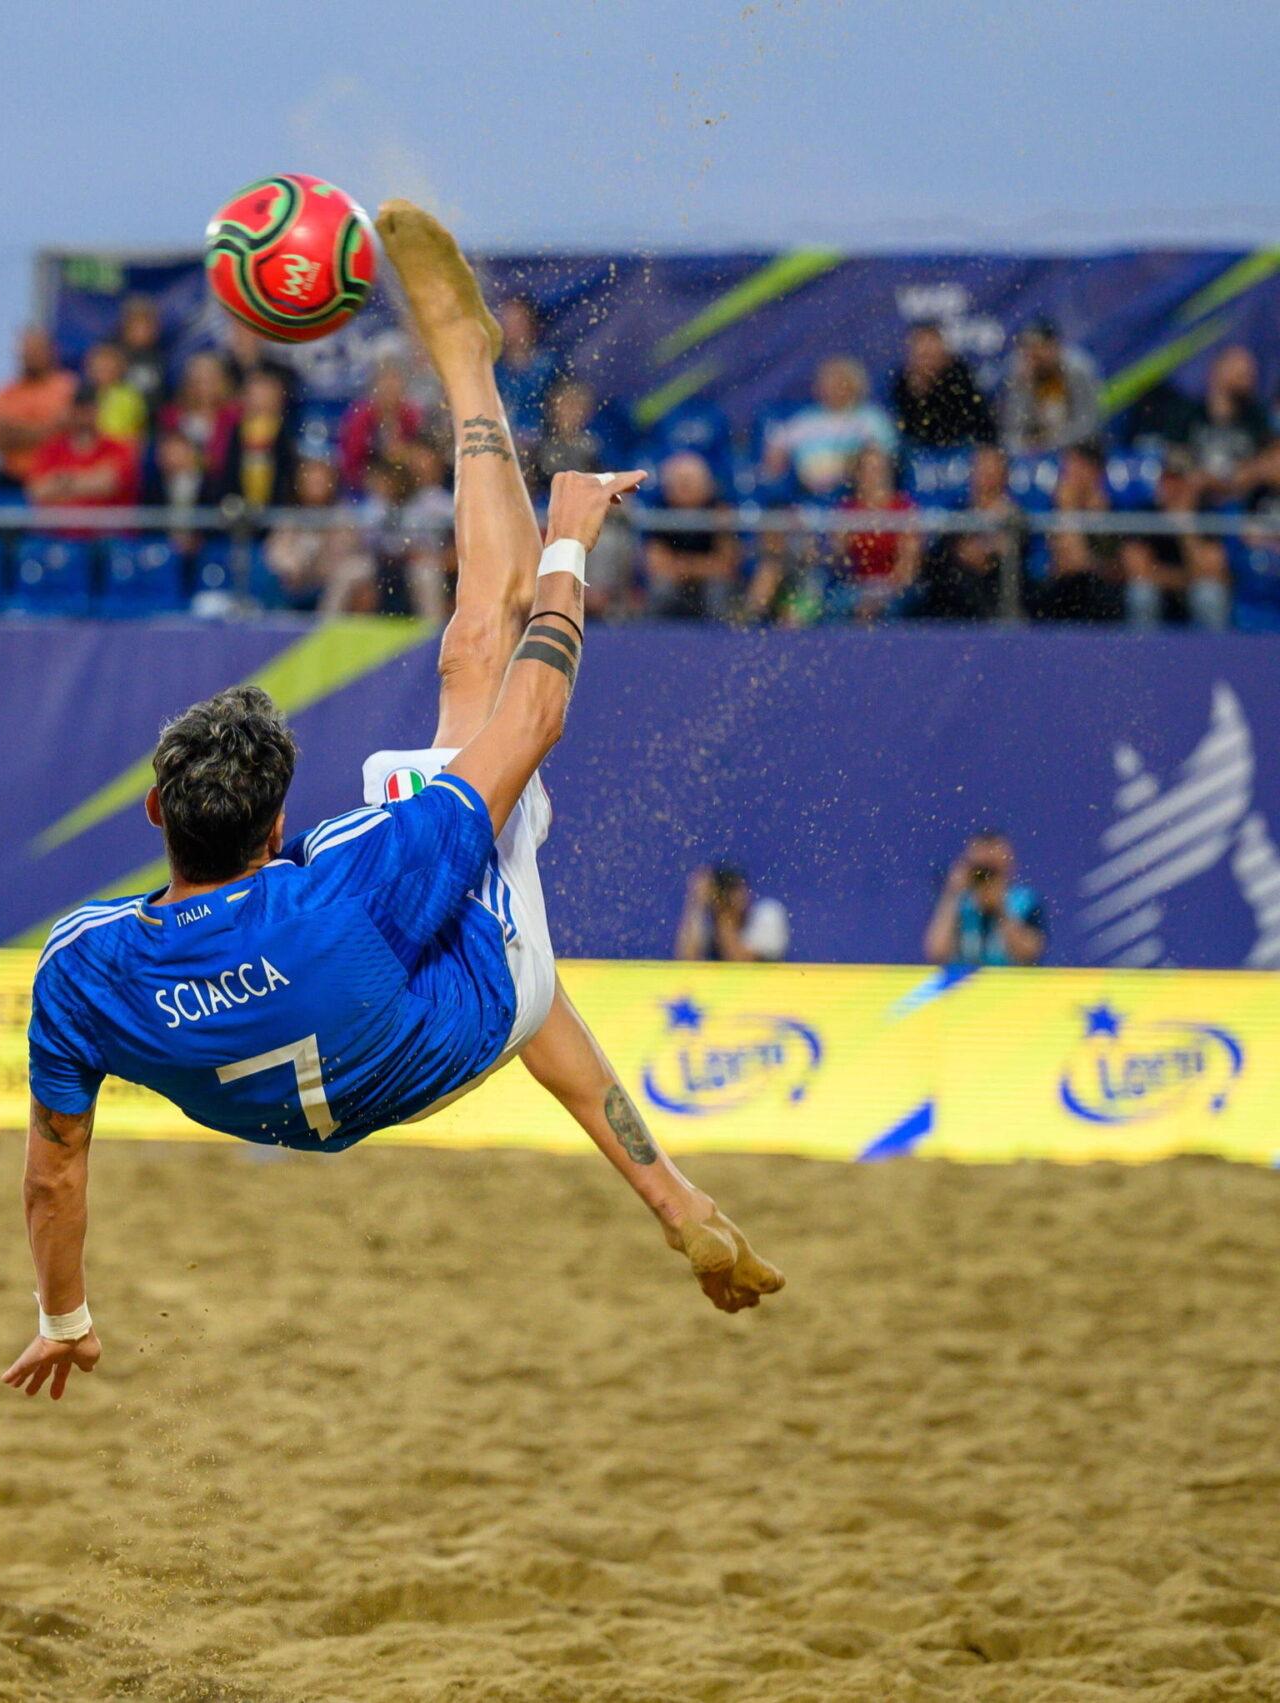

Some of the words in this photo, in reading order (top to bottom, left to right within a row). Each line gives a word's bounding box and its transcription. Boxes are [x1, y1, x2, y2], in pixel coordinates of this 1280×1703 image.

[176, 903, 212, 928] ITALIA
[155, 955, 291, 1029] SCIACCA
[215, 1033, 342, 1142] 7
